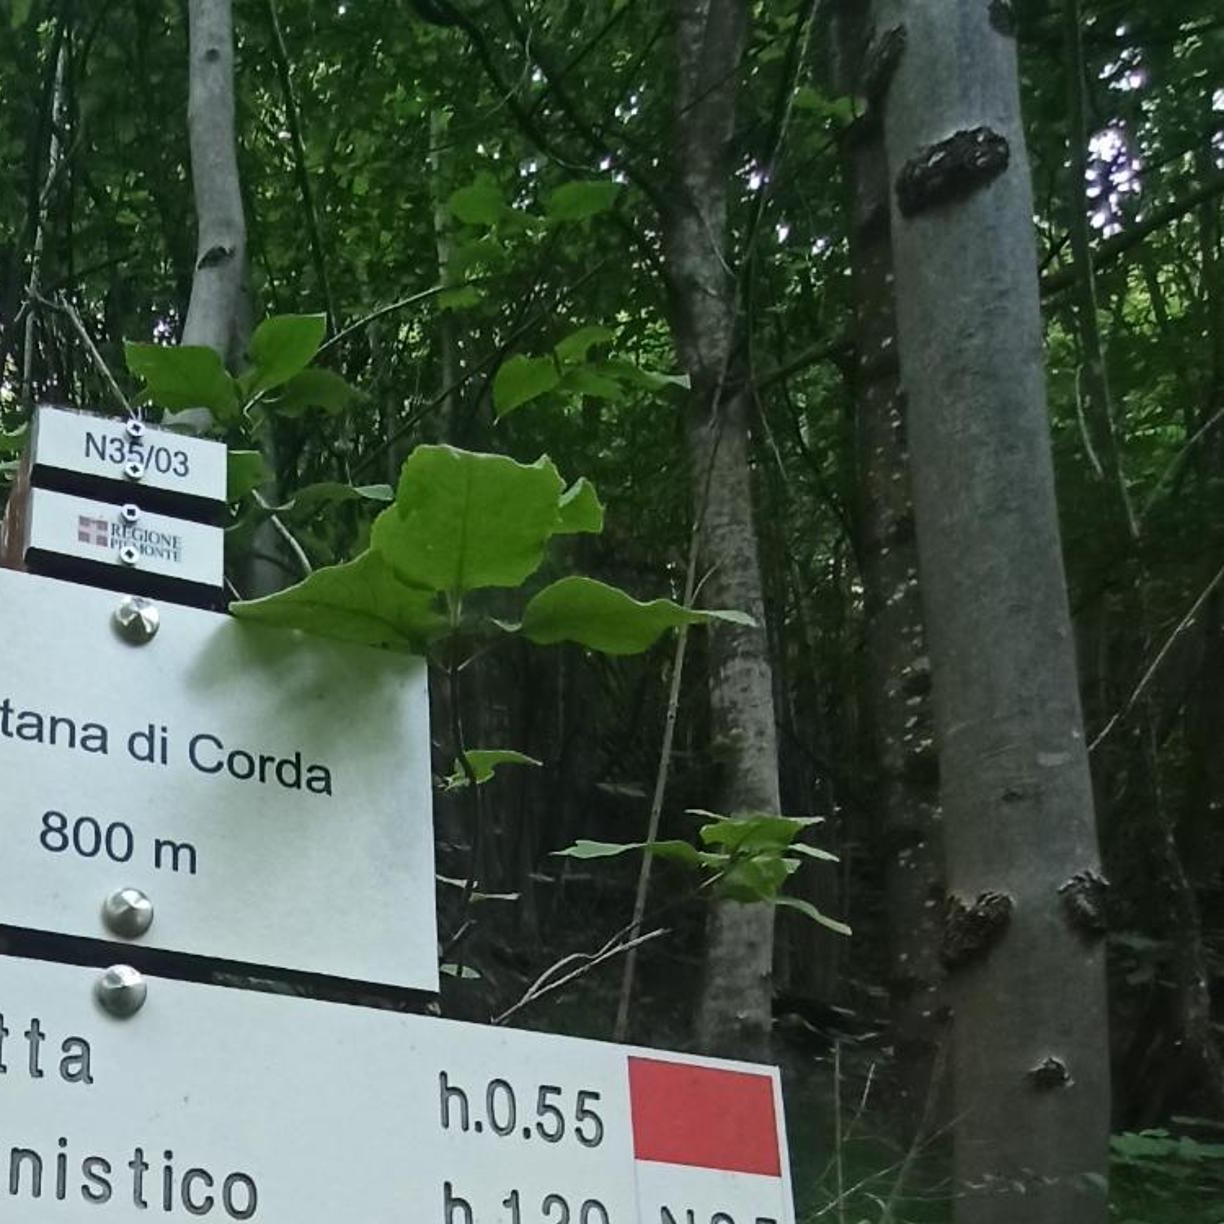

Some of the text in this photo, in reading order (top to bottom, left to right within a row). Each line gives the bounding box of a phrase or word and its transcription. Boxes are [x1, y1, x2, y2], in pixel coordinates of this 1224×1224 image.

[85, 432, 190, 477] N35/03
[111, 523, 183, 547] REGIONE
[128, 724, 167, 765] di
[189, 735, 332, 796] Corda
[40, 811, 196, 874] 800 m
[439, 1071, 604, 1147] h.0.55
